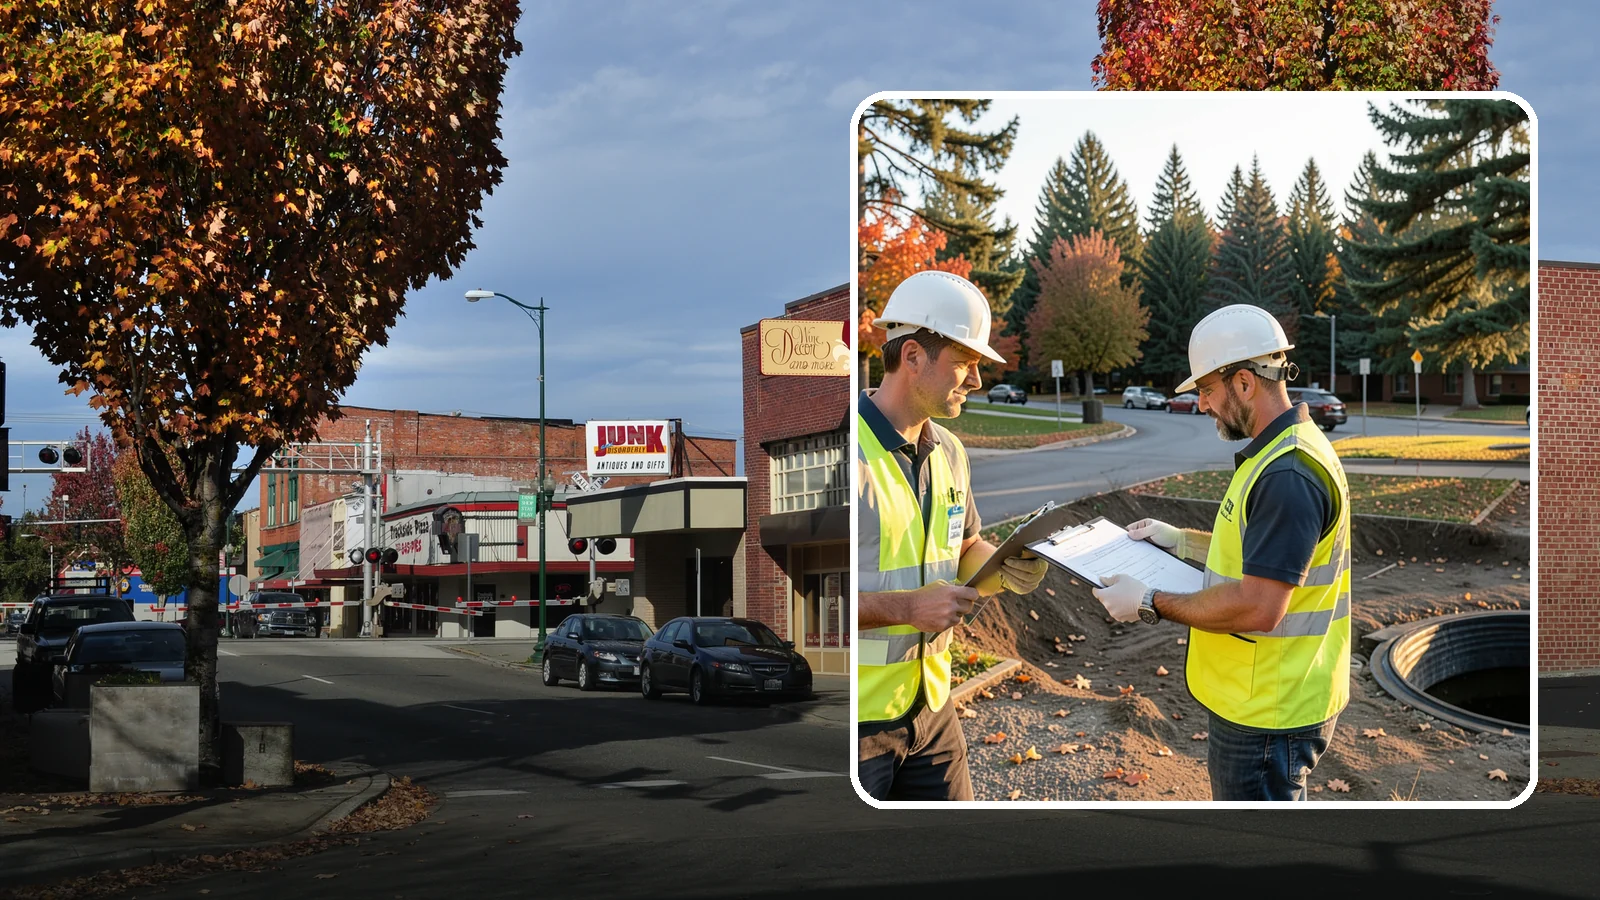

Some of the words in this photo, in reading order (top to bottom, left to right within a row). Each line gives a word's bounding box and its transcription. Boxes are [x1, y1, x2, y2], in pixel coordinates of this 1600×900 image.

[595, 425, 665, 457] JUNK
[607, 445, 646, 454] DISORDERLY
[596, 461, 628, 470] ANTIQUES
[631, 461, 644, 470] AND
[647, 460, 665, 469] GIFTS
[415, 519, 429, 534] Pizza
